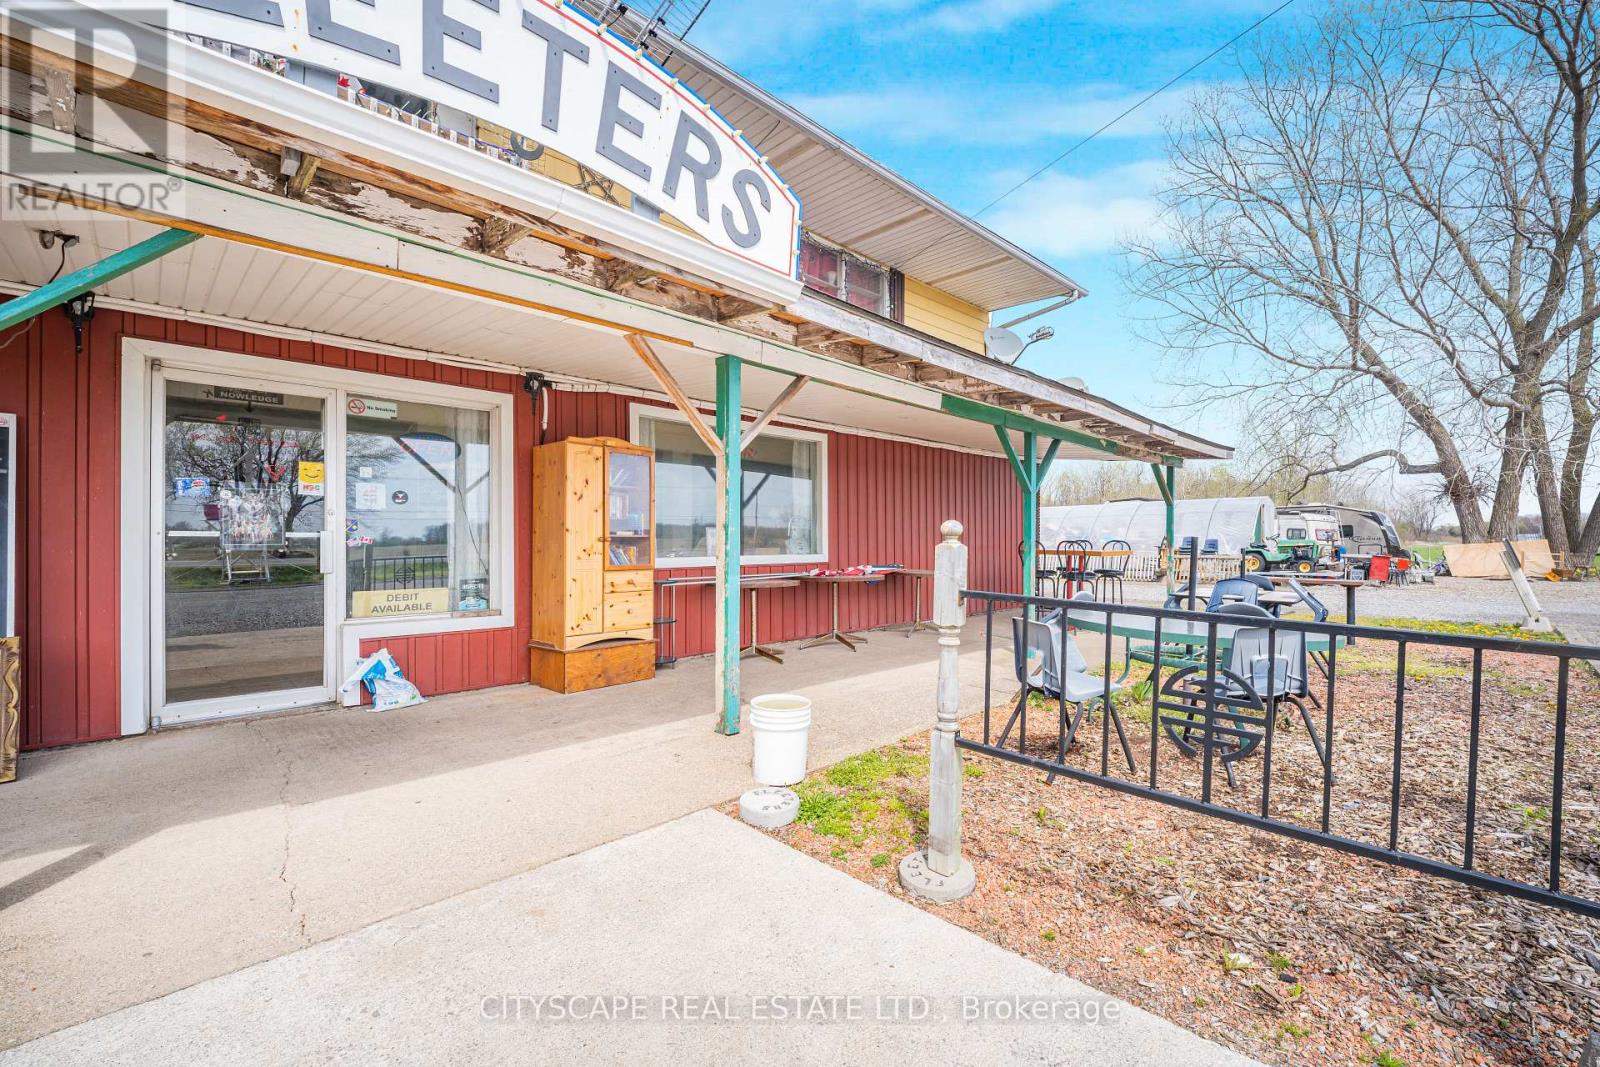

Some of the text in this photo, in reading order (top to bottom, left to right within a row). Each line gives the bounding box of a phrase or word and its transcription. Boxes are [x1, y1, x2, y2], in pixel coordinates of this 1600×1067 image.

[173, 0, 771, 249] ETERS
[386, 592, 420, 602] DEBIT
[371, 602, 433, 614] AVAILABLE
